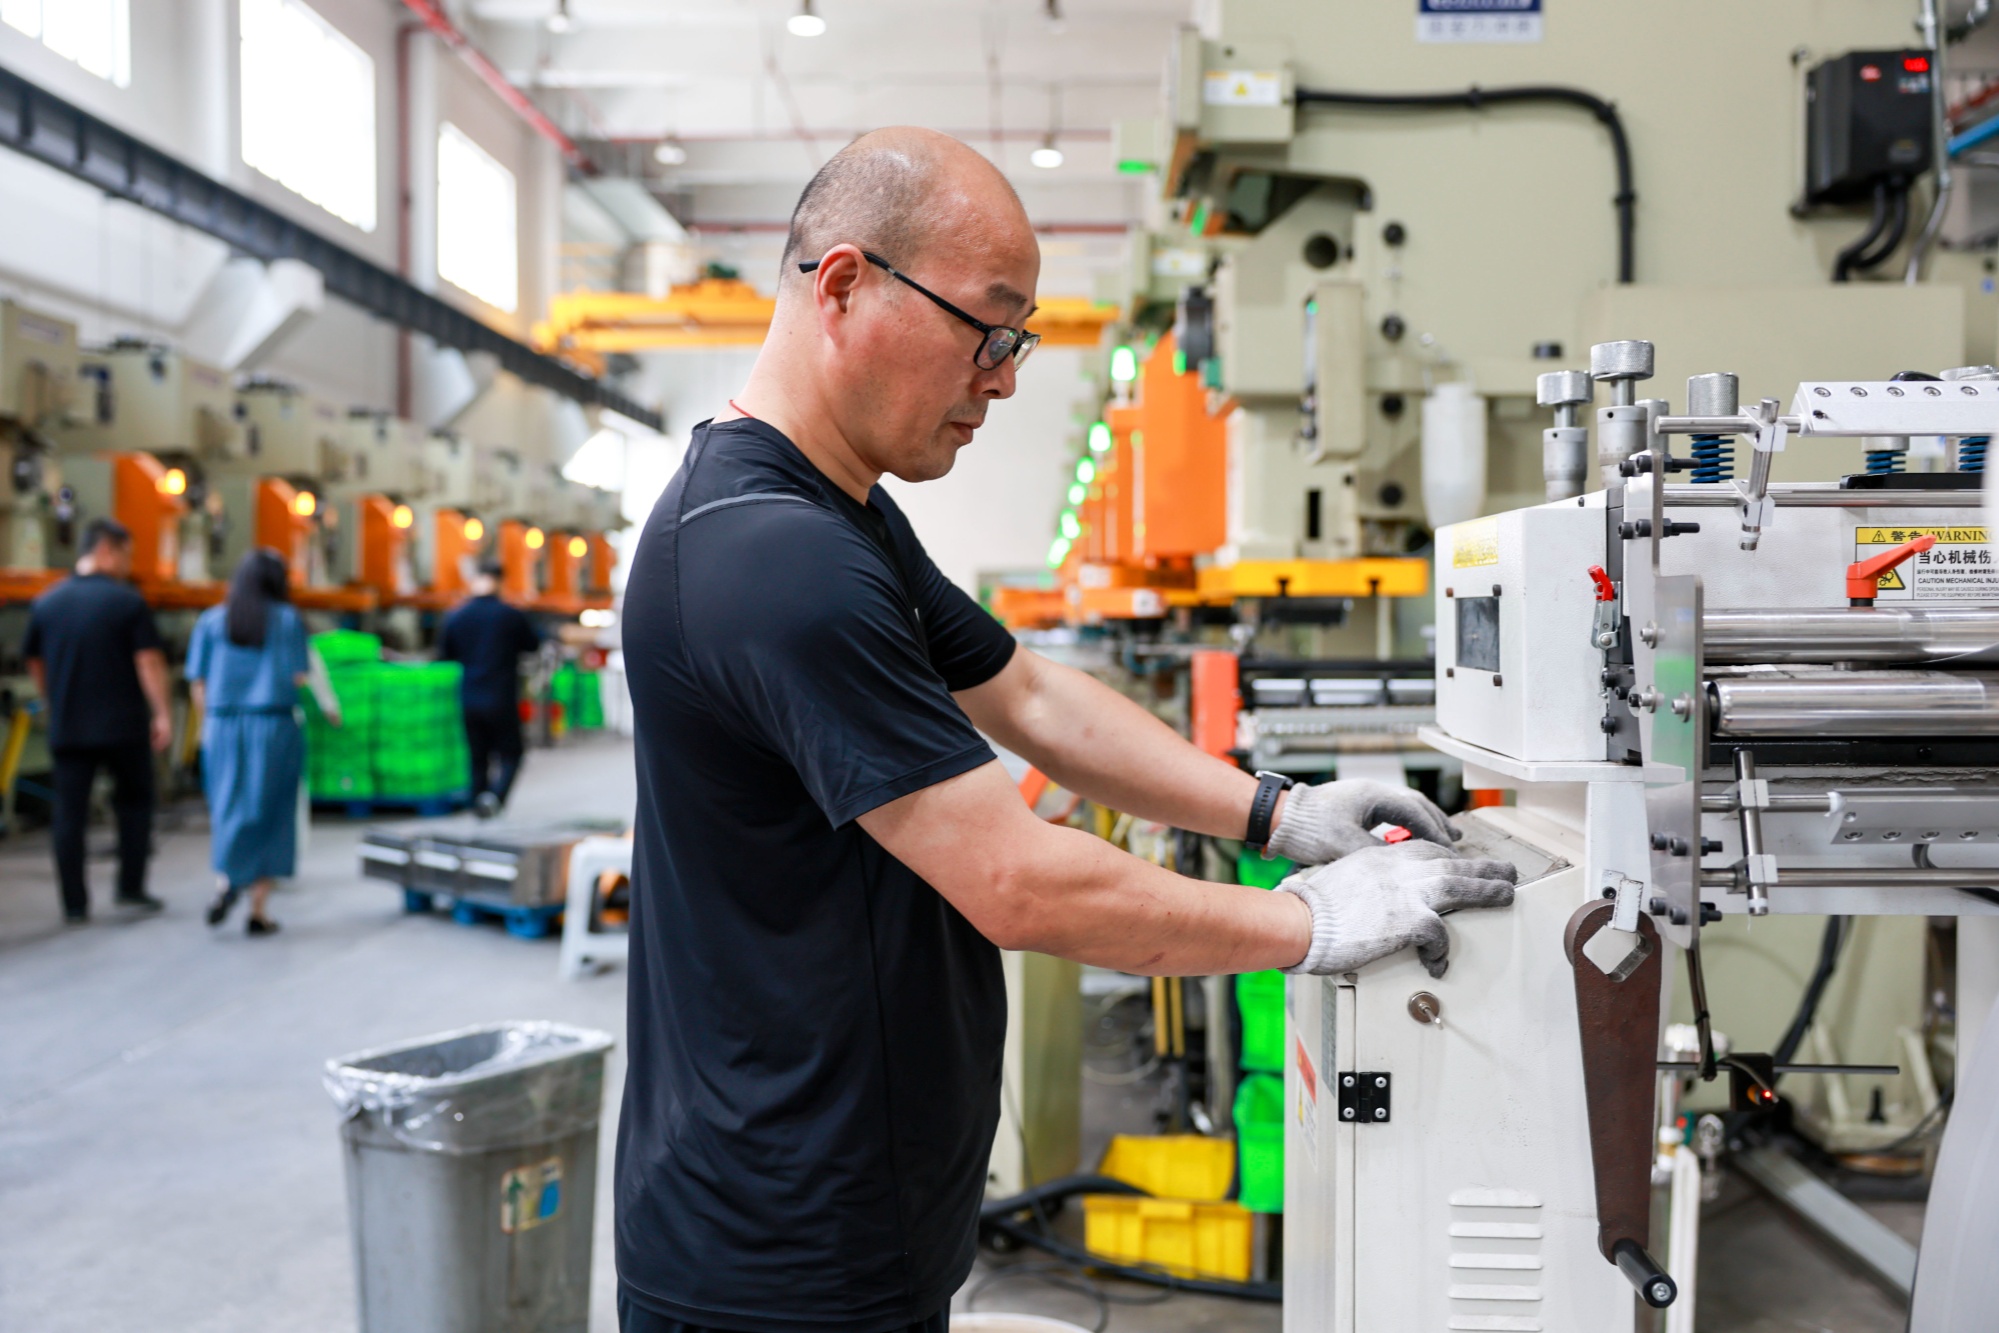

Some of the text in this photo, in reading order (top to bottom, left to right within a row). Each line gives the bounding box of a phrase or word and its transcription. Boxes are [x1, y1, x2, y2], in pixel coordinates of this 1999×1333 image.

[1918, 549, 1999, 565] 当心机械伤
